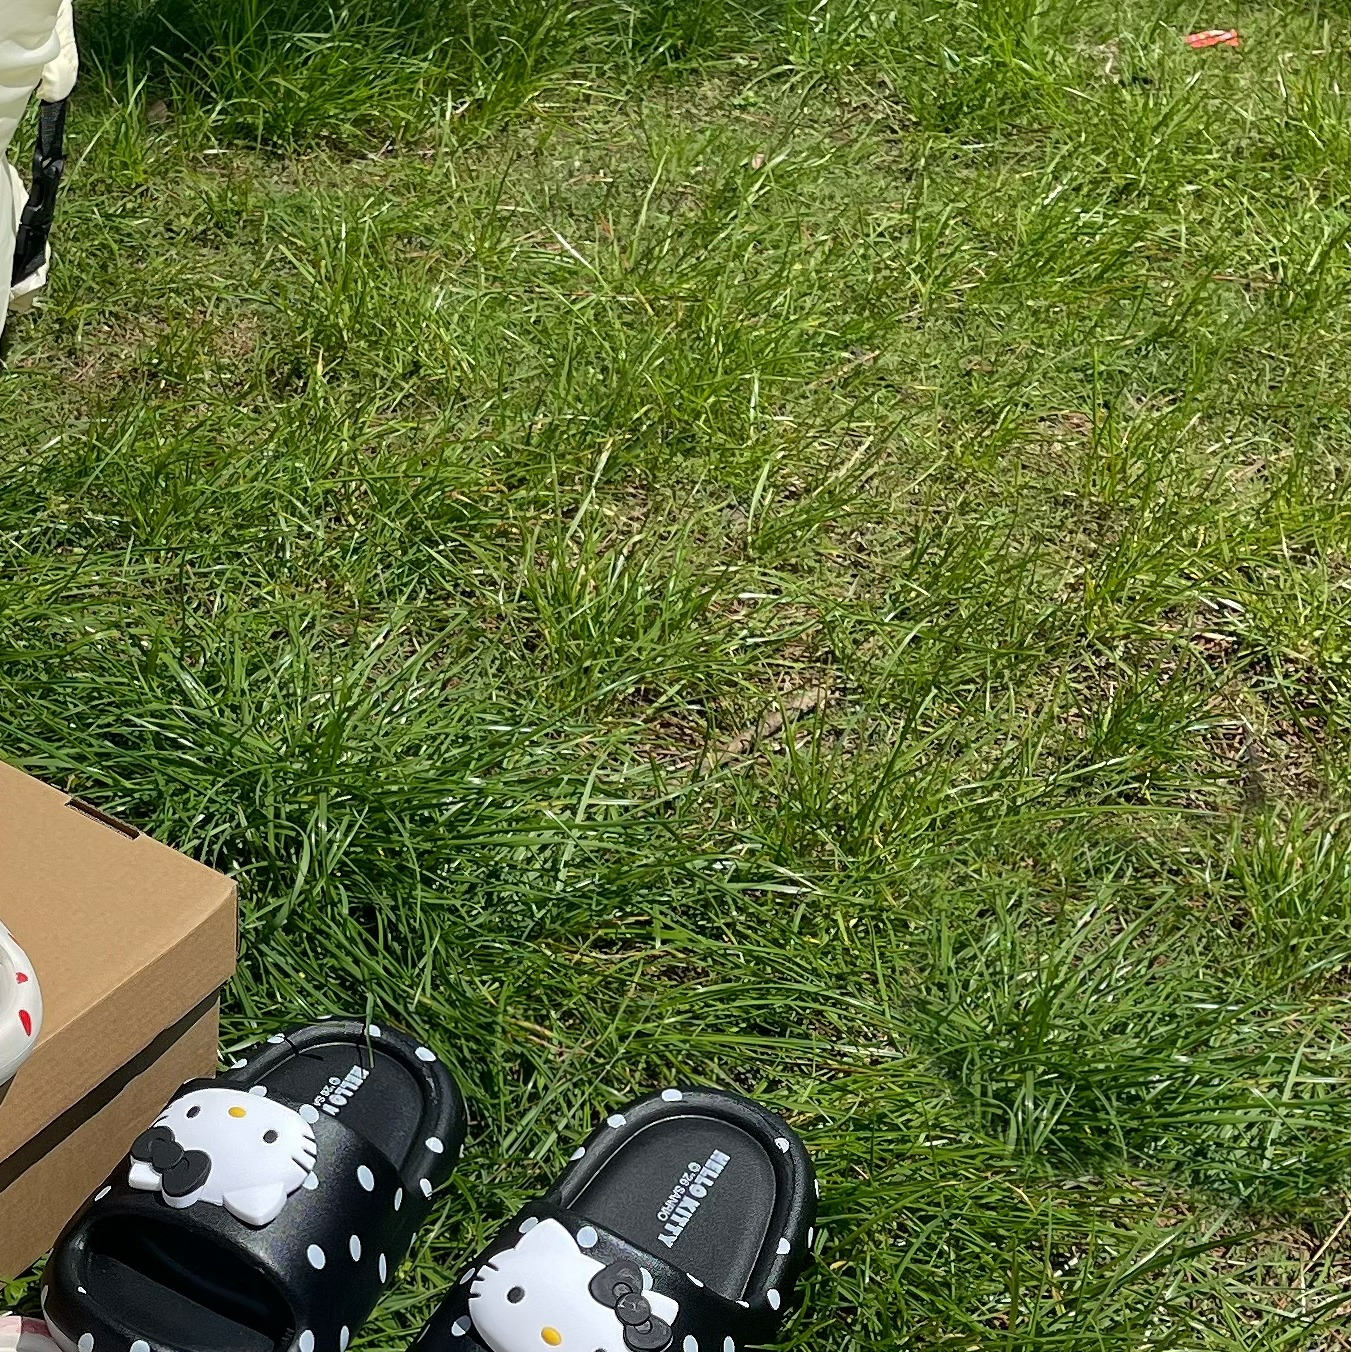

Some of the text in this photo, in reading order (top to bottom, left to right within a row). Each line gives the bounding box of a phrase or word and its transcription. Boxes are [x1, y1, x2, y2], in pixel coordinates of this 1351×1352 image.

[328, 1064, 370, 1106] HELLO
[657, 1149, 731, 1249] HELLO KITTY
[657, 1185, 686, 1221] SANRIO
